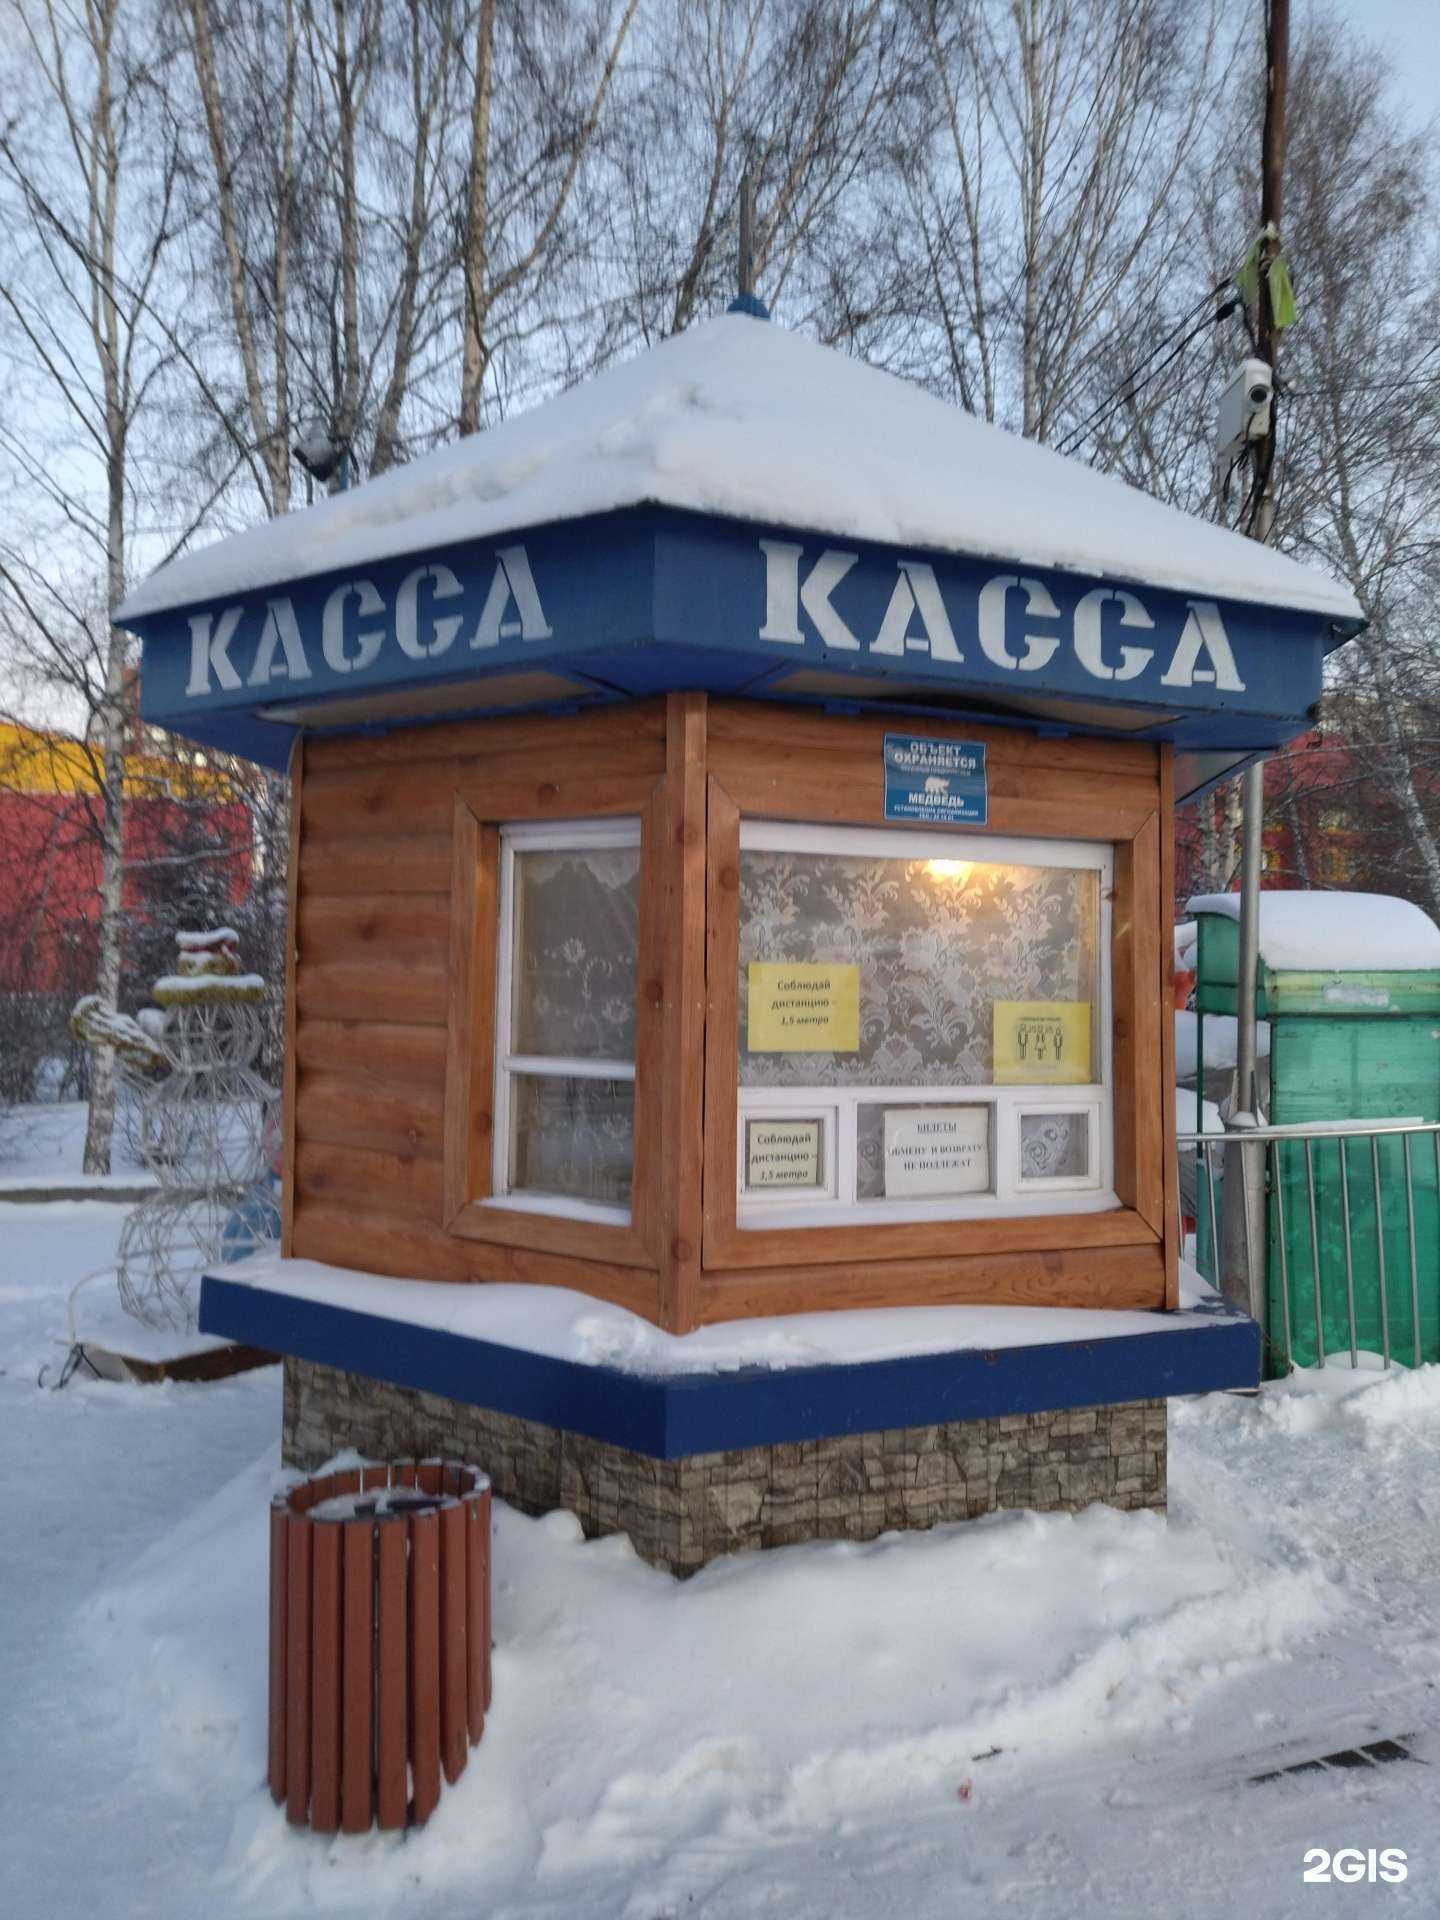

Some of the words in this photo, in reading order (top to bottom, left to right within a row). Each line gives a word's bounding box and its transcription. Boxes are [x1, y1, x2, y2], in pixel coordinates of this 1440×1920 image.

[185, 545, 552, 697] КАССА
[759, 538, 1246, 692] КАССА
[910, 741, 961, 756] ОБЪЕКТ
[894, 752, 976, 769] ОХРАНЯЕТСЯ
[908, 792, 964, 808] МЕДВЕДЬ
[777, 979, 831, 992] Соблюдай
[771, 999, 830, 1012] дистанцию
[797, 1016, 829, 1026] метра
[917, 1122, 957, 1134] БИЛЕТЫ
[757, 1133, 812, 1146] Соблюдай
[931, 1146, 938, 1156] И
[940, 1144, 983, 1155] ВОЗВРАТУ
[751, 1152, 810, 1165] дистанцию
[904, 1161, 917, 1171] НЕ
[919, 1159, 971, 1170] ПОДЛЕЖАТ
[761, 1171, 774, 1181] 1,5
[776, 1170, 808, 1179] метра
